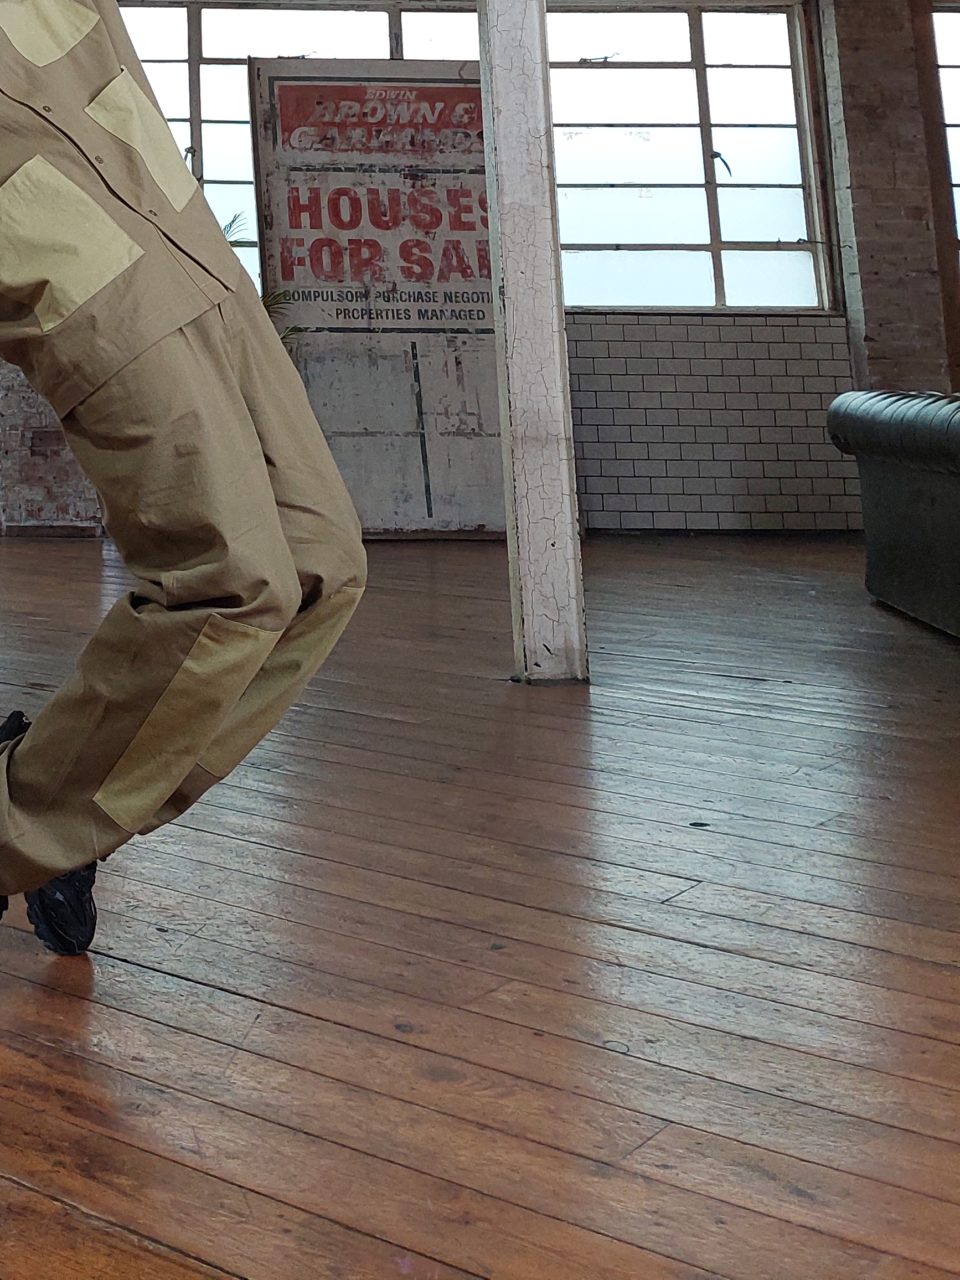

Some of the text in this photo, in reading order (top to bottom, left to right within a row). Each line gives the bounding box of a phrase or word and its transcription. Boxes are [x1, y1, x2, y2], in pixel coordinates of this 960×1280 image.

[365, 89, 418, 100] EDWIN
[308, 100, 477, 125] BROWN &
[279, 237, 384, 283] FOR
[374, 291, 439, 303] PURCHASE
[443, 291, 494, 304] NEGOTI
[335, 307, 486, 321] PROPERTIES MANAGED
